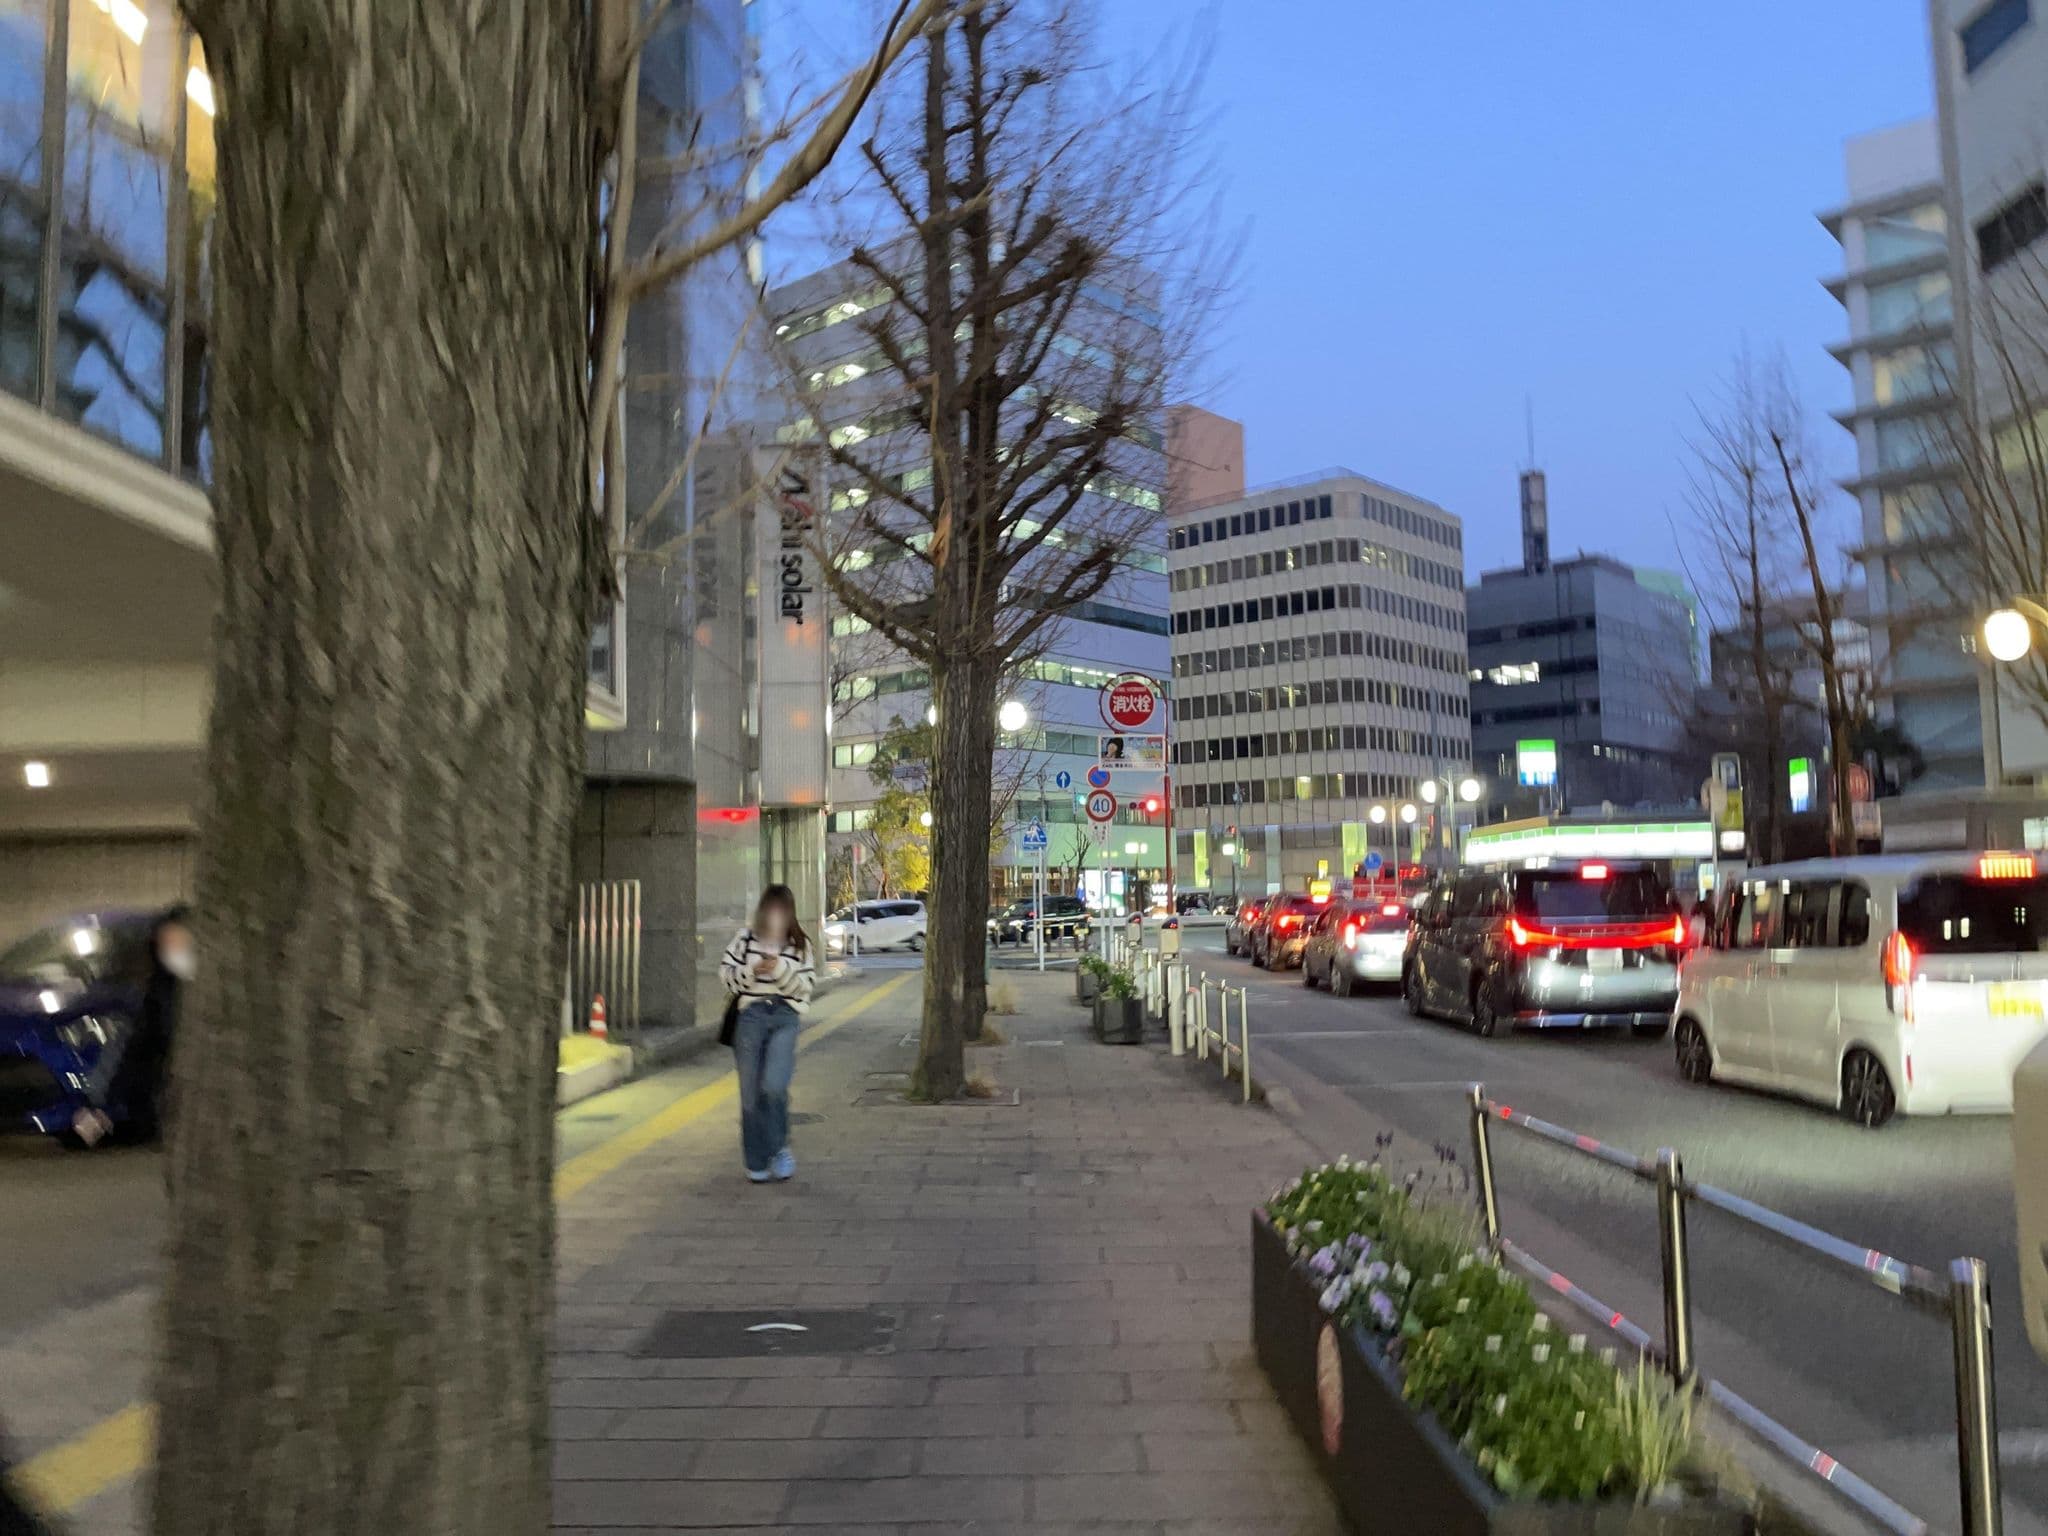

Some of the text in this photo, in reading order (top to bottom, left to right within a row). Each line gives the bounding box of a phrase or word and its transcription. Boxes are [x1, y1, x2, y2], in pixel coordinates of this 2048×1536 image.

[781, 554, 813, 625] solar
[1112, 694, 1151, 713] 消火栓
[1092, 798, 1110, 813] 40
